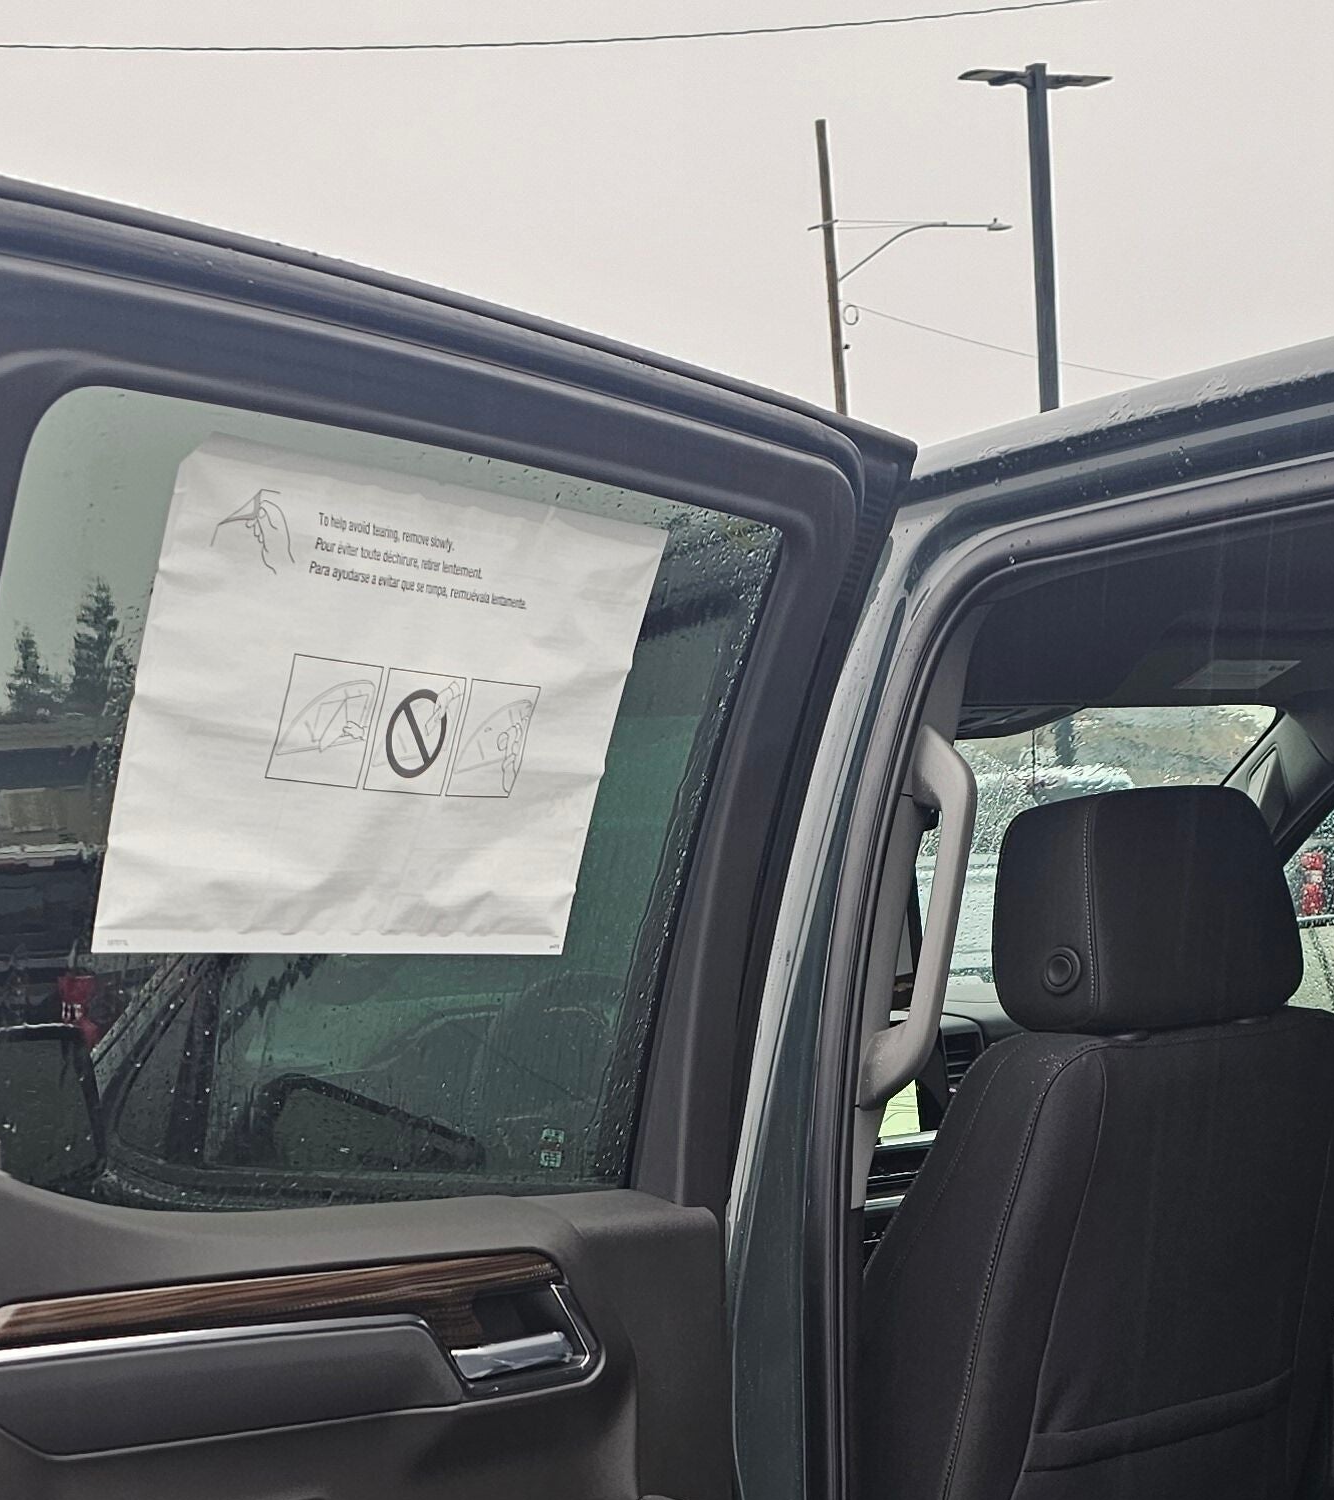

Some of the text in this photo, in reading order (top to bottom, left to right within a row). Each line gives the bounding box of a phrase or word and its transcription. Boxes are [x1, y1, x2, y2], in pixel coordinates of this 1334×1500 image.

[315, 537, 336, 552] Pour
[337, 541, 359, 557] éviter
[360, 546, 382, 561] toute
[318, 512, 455, 553] To help avoid tearing, remove slowly.
[309, 560, 330, 577] Para
[332, 567, 370, 583] ayudarse
[371, 575, 377, 585] a
[378, 574, 400, 588] evitar
[401, 579, 415, 592] que
[416, 582, 425, 593] se
